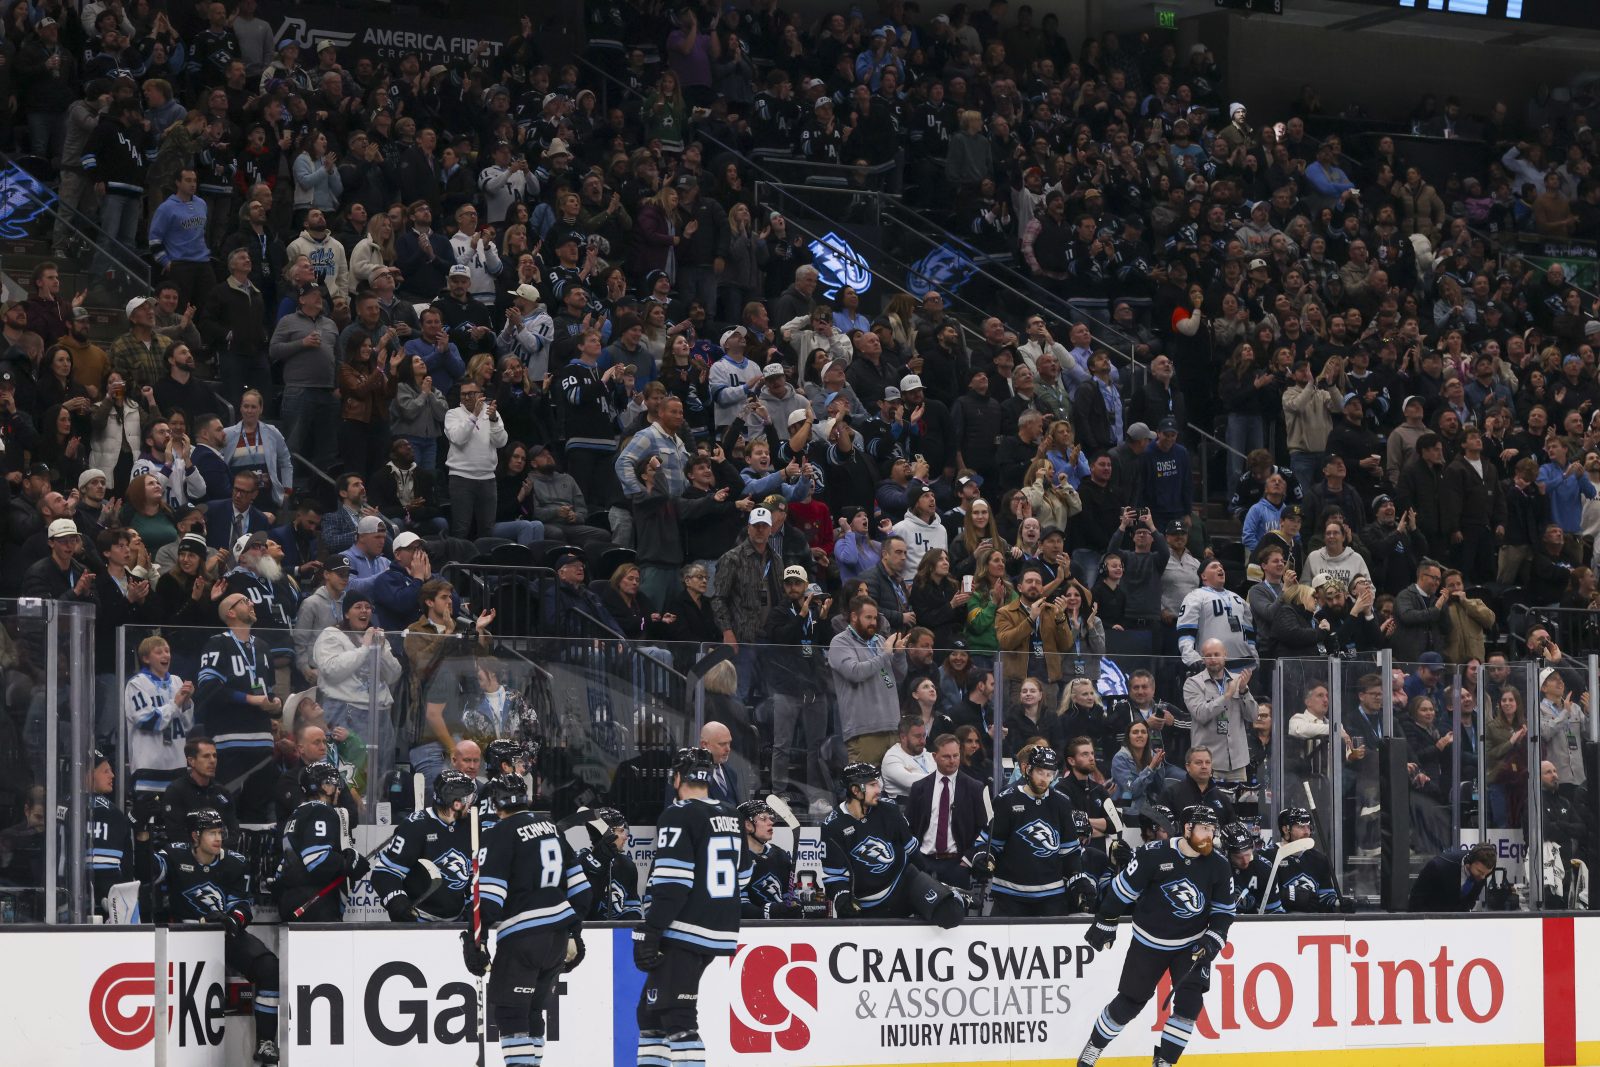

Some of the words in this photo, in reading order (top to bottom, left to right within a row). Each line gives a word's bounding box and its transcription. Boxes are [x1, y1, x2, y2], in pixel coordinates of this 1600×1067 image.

[1159, 12, 1176, 27] EXIT
[363, 27, 447, 51] AMERICA
[377, 48, 433, 63] CREIT
[538, 323, 549, 337] 11
[200, 650, 220, 669] 67
[131, 690, 148, 712] 11
[697, 770, 708, 780] 67
[87, 821, 109, 841] 41
[314, 820, 327, 837] 9
[657, 827, 683, 849] 67
[478, 847, 488, 867] 8
[540, 838, 563, 889] 8
[1248, 875, 1258, 891] A
[828, 942, 954, 984] CRAIG
[967, 940, 1095, 982] SWAPP
[1297, 934, 1505, 1028] Tinto
[855, 989, 878, 1020] &
[884, 984, 1072, 1018] ASSOCIATES
[880, 1023, 944, 1047] INJURY
[949, 1020, 1048, 1046] ATTORNEYS
